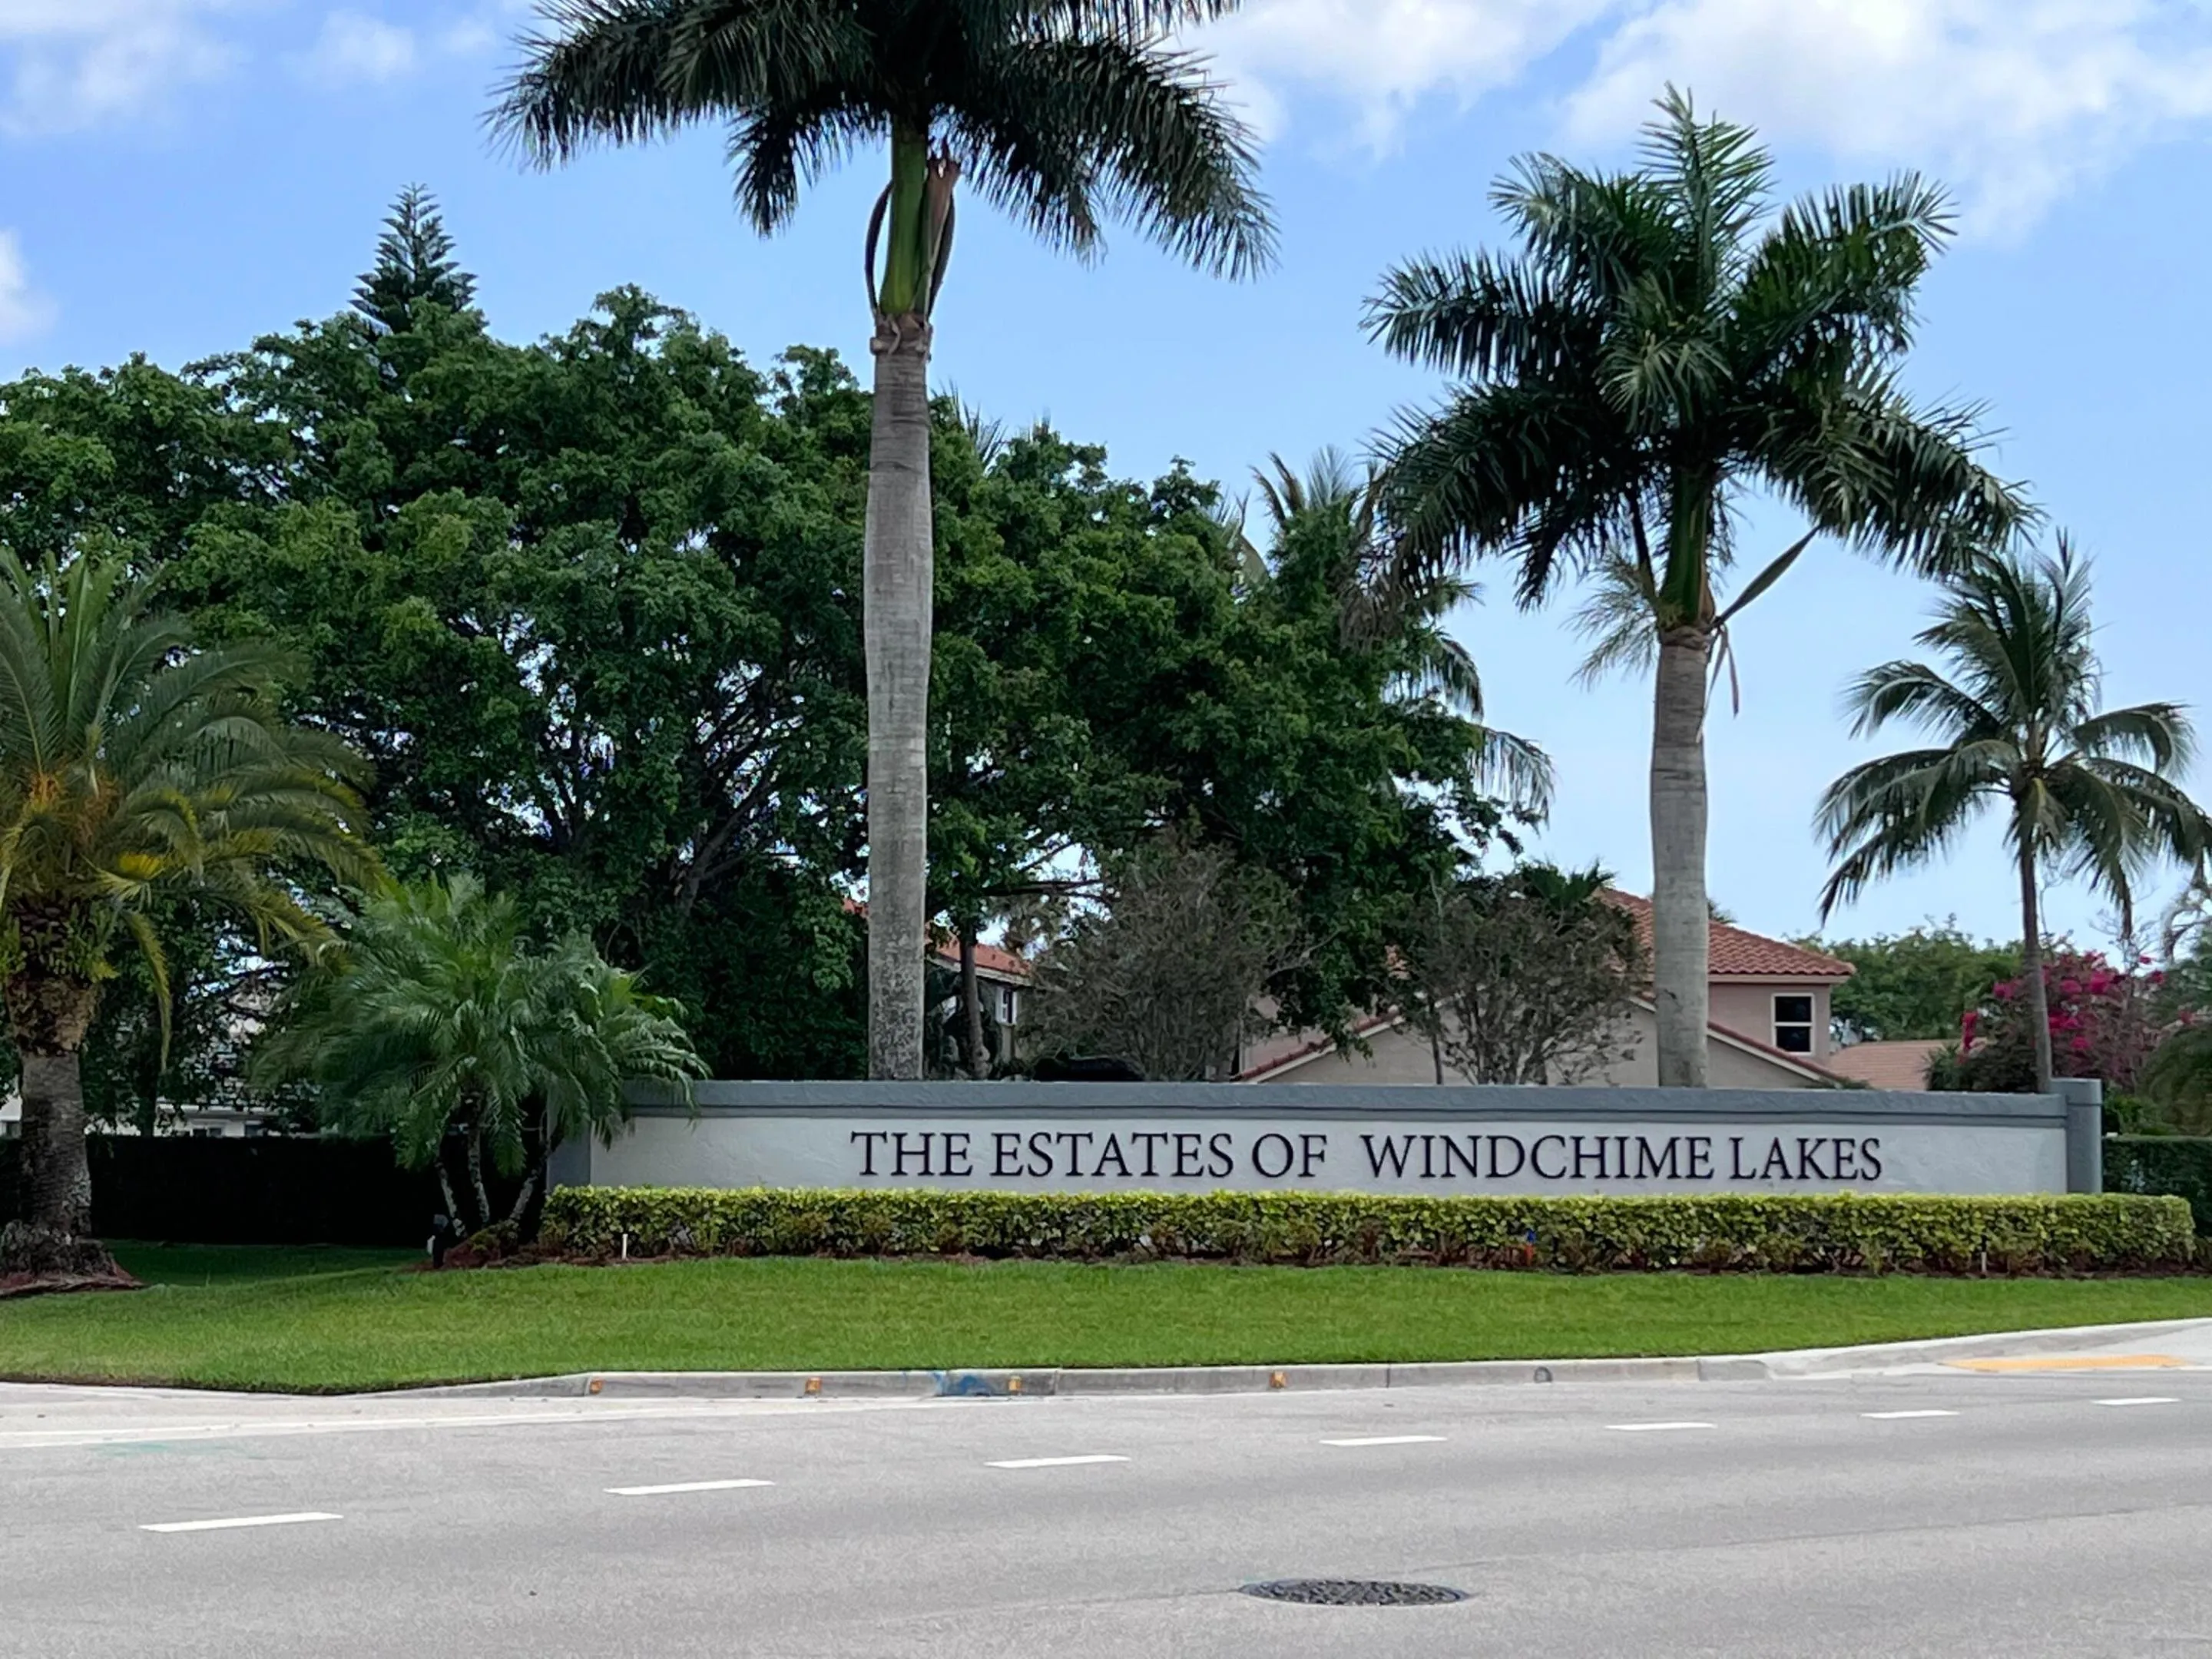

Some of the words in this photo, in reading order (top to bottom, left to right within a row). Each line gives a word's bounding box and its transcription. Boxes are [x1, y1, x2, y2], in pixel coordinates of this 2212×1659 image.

[850, 1132, 974, 1177] THE
[989, 1132, 1234, 1179] ESTATES
[1251, 1133, 1328, 1179] OF
[1359, 1134, 1716, 1181] WINDCHIME
[1728, 1137, 1883, 1182] LAKES
